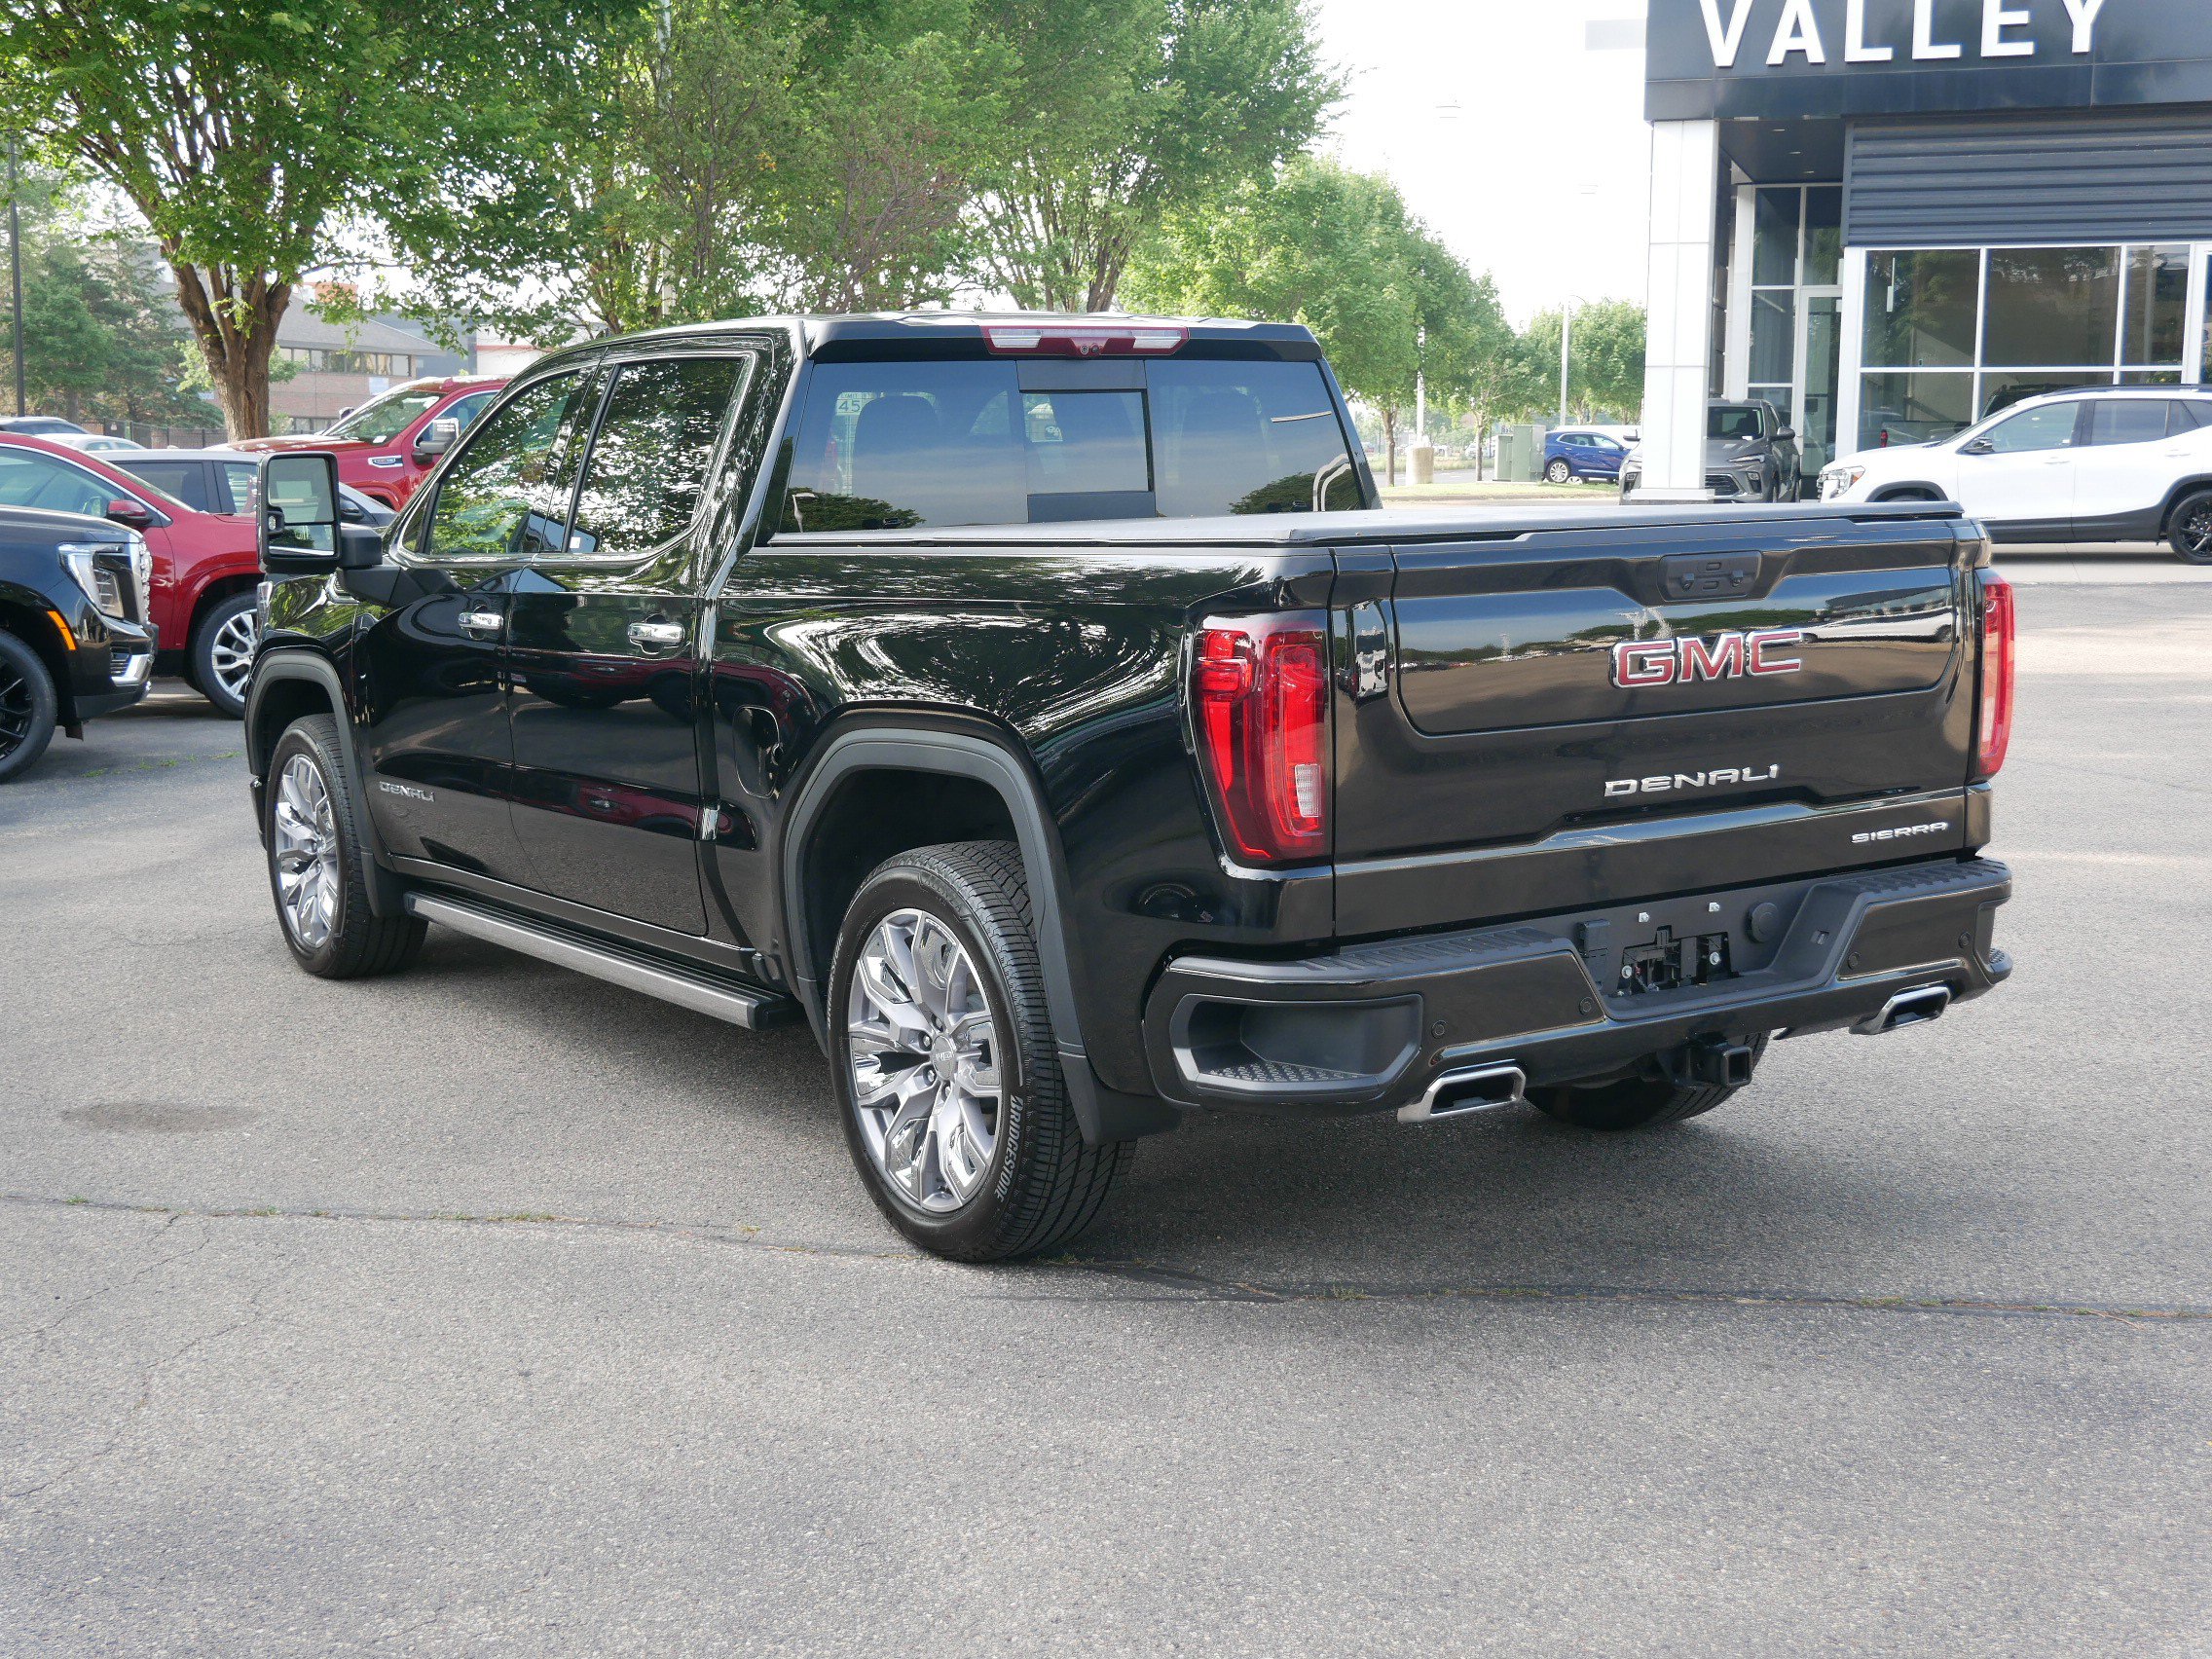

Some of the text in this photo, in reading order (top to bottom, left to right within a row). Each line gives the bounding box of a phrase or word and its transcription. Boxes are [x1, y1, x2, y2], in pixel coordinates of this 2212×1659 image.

[1698, 0, 2106, 67] VALLEY
[838, 399, 861, 412] 45
[1608, 628, 1802, 689] GMC
[379, 781, 435, 803] DENALI
[1604, 763, 1780, 797] DENALI
[1851, 821, 1948, 844] SIERRA
[994, 1094, 1024, 1203] BRIDGESTONE
